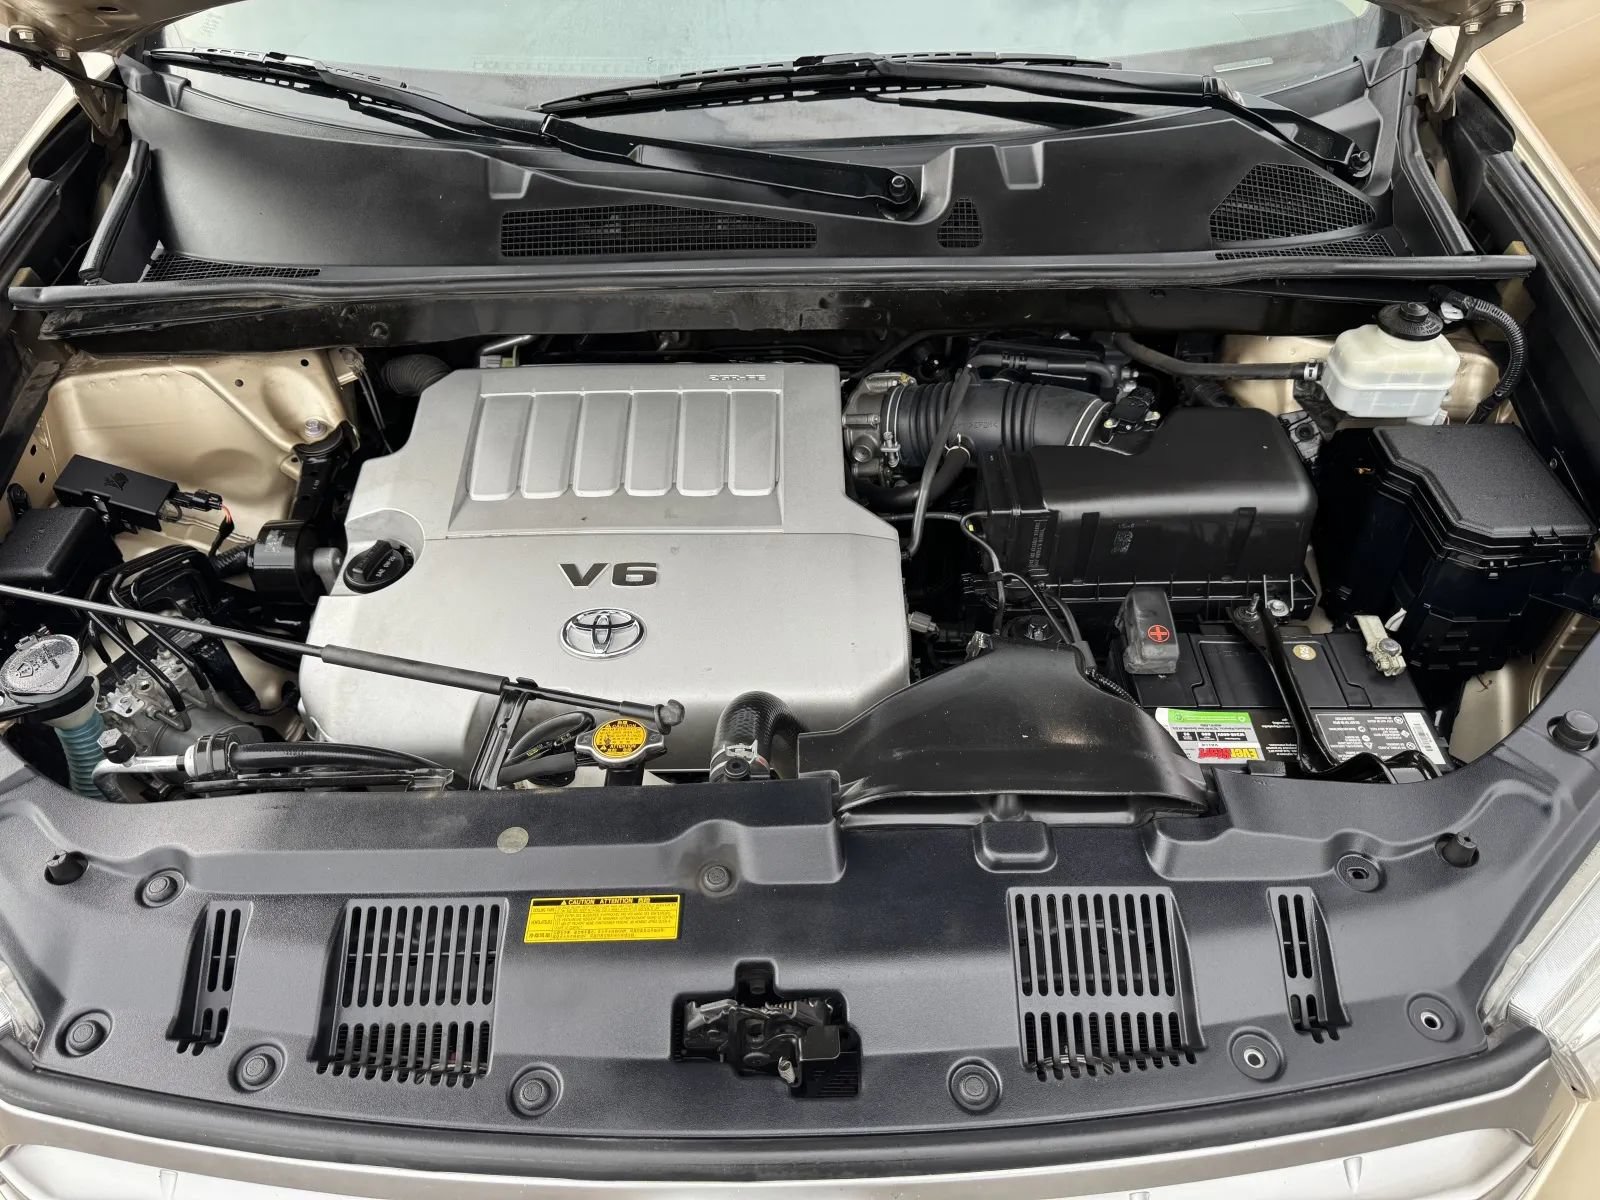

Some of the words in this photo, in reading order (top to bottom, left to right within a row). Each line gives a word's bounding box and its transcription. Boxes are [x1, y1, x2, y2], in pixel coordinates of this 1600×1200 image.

[558, 562, 657, 589] V6
[1198, 748, 1259, 760] EverStart
[568, 898, 595, 906] CAUTION
[599, 897, 633, 905] ATTENTION
